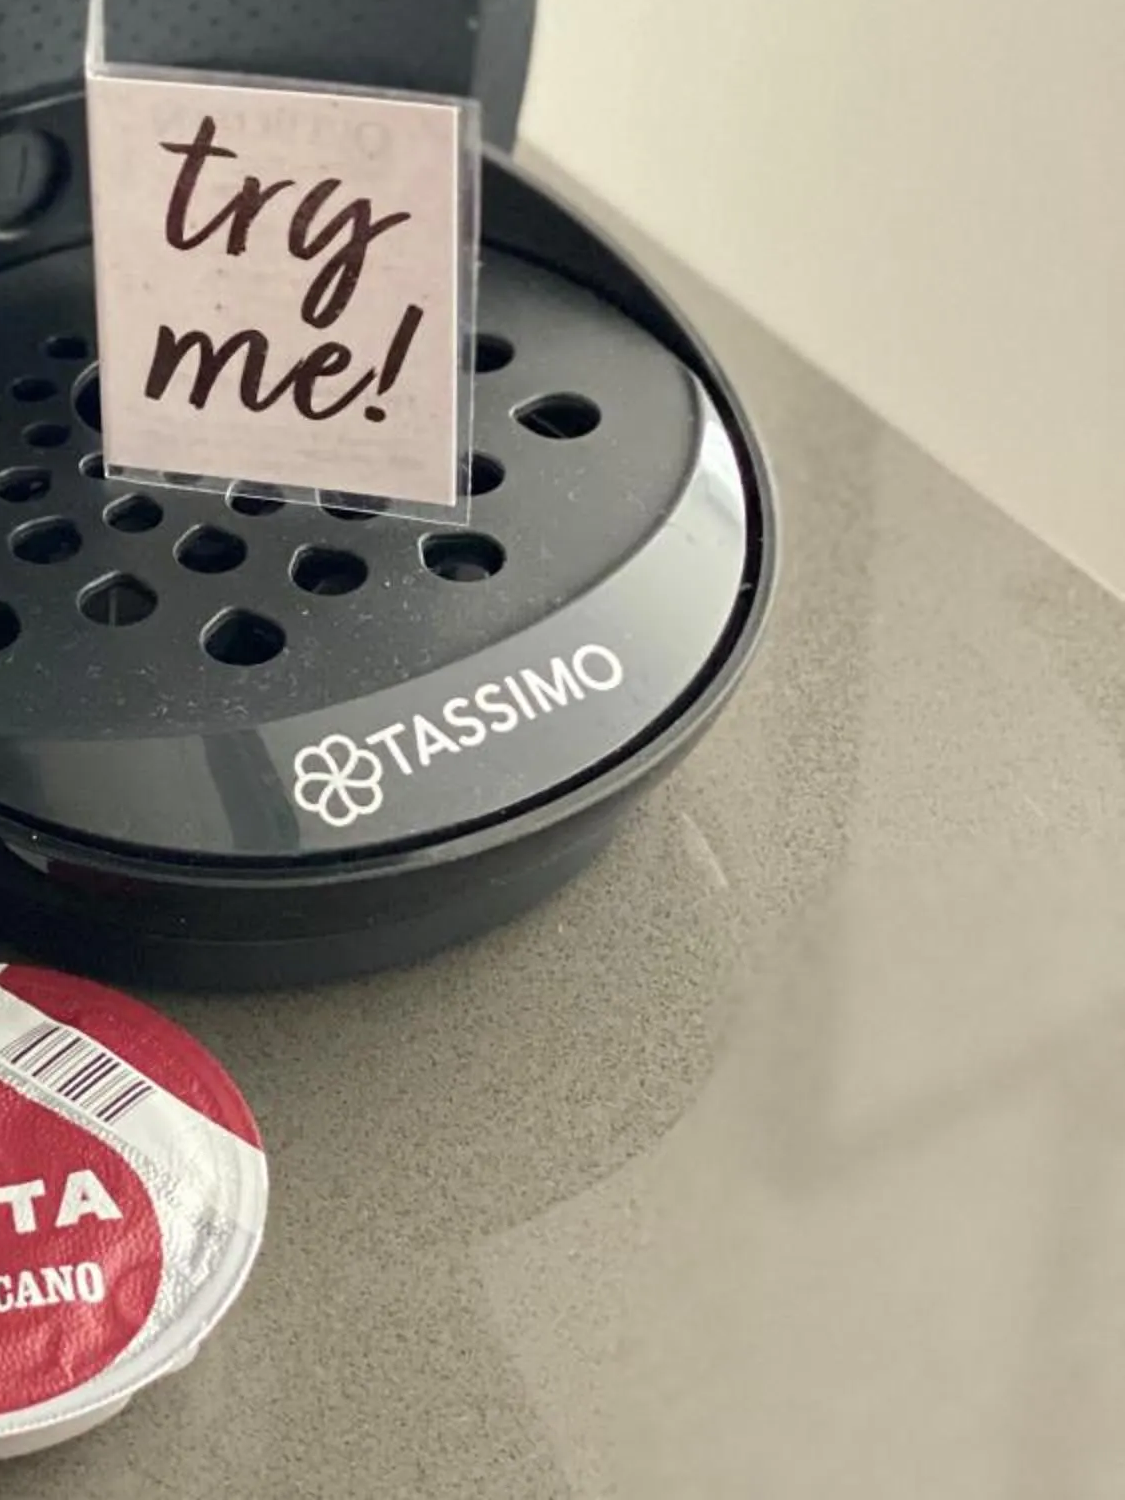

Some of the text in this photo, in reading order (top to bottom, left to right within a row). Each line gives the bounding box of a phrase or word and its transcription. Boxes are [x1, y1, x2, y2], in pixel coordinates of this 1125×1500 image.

[159, 115, 411, 329] try
[144, 303, 424, 423] me!
[365, 643, 623, 776] TASSIMO
